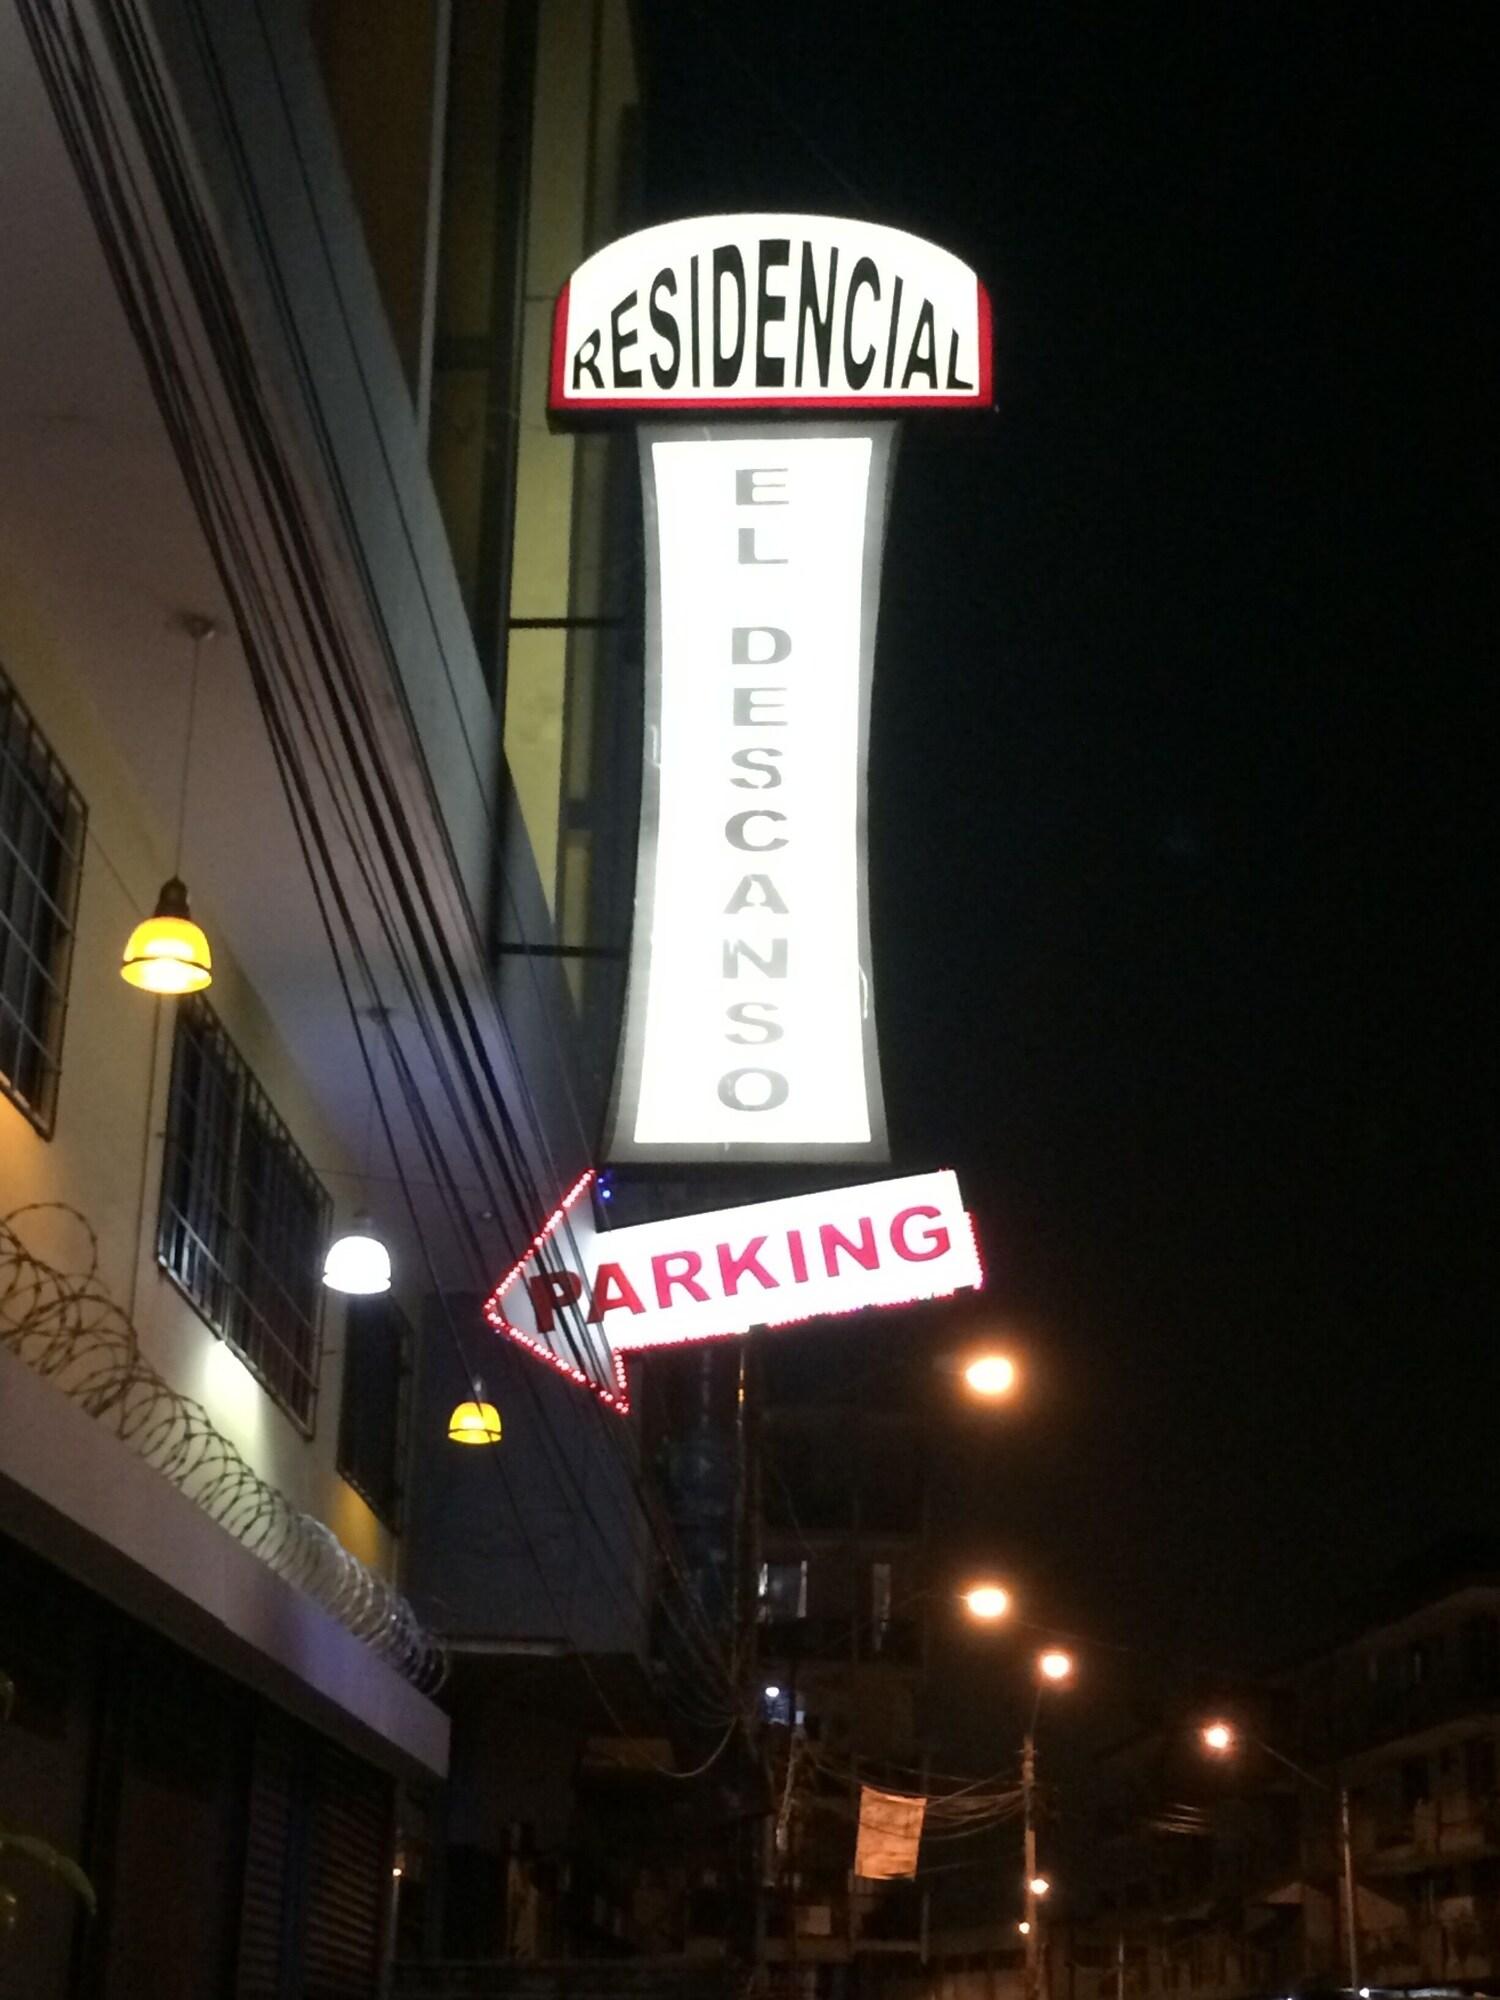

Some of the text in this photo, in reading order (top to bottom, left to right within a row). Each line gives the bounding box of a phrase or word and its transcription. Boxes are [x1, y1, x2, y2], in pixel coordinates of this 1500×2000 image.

[572, 238, 974, 391] RESIDENCIAL
[717, 468, 792, 1112] EL DESCANSO
[529, 1205, 951, 1333] PARKING
